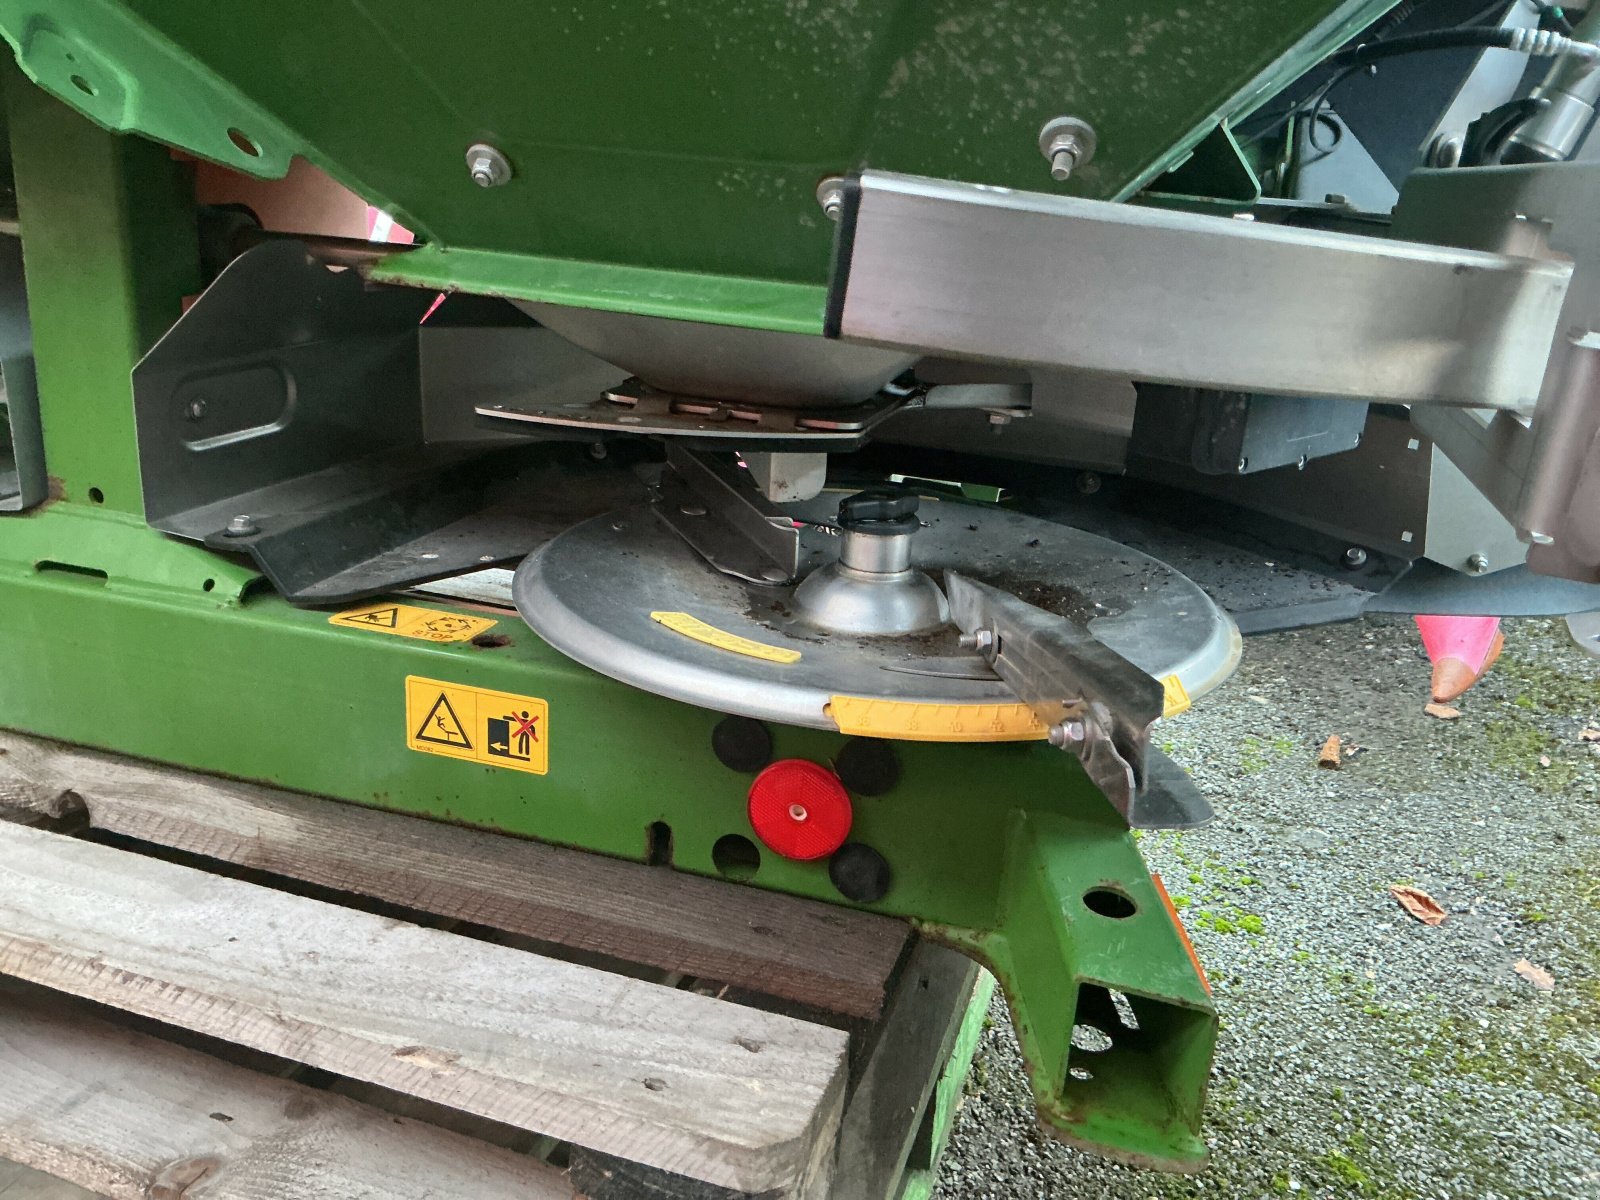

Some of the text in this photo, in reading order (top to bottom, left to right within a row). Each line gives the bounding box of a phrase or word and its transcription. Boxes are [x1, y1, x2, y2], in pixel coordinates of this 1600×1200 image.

[412, 630, 453, 640] STOP
[905, 719, 919, 730] 38
[990, 720, 1005, 732] 42
